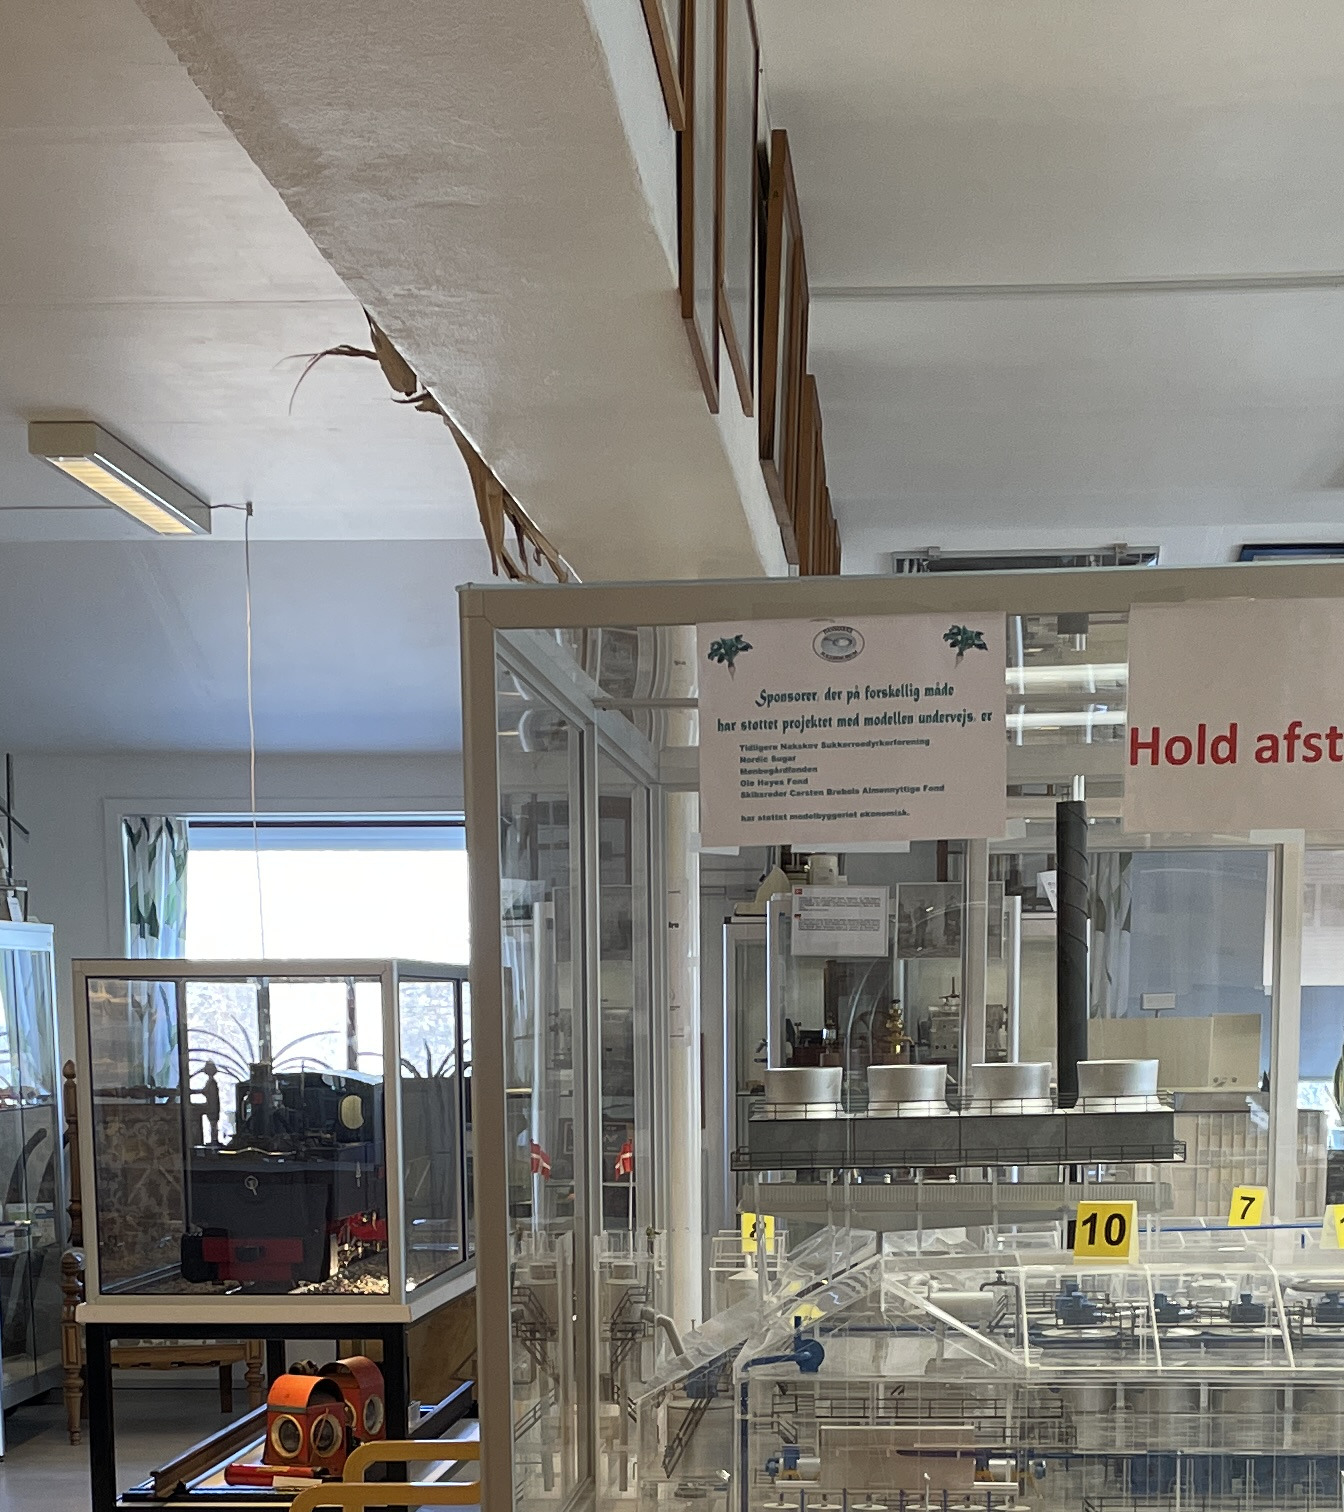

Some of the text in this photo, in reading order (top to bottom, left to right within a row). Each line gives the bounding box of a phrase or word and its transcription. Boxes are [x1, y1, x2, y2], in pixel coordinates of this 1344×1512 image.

[824, 687, 842, 700] der
[847, 686, 860, 704] på
[865, 683, 920, 702] forskellig
[924, 682, 954, 697] måde
[717, 719, 736, 732] har
[783, 715, 832, 734] projektet
[837, 713, 859, 727] med
[864, 711, 914, 726] modellen
[981, 711, 992, 721] er
[1129, 724, 1238, 767] Hold
[1239, 1196, 1255, 1219] 7
[1081, 1212, 1127, 1246] 10
